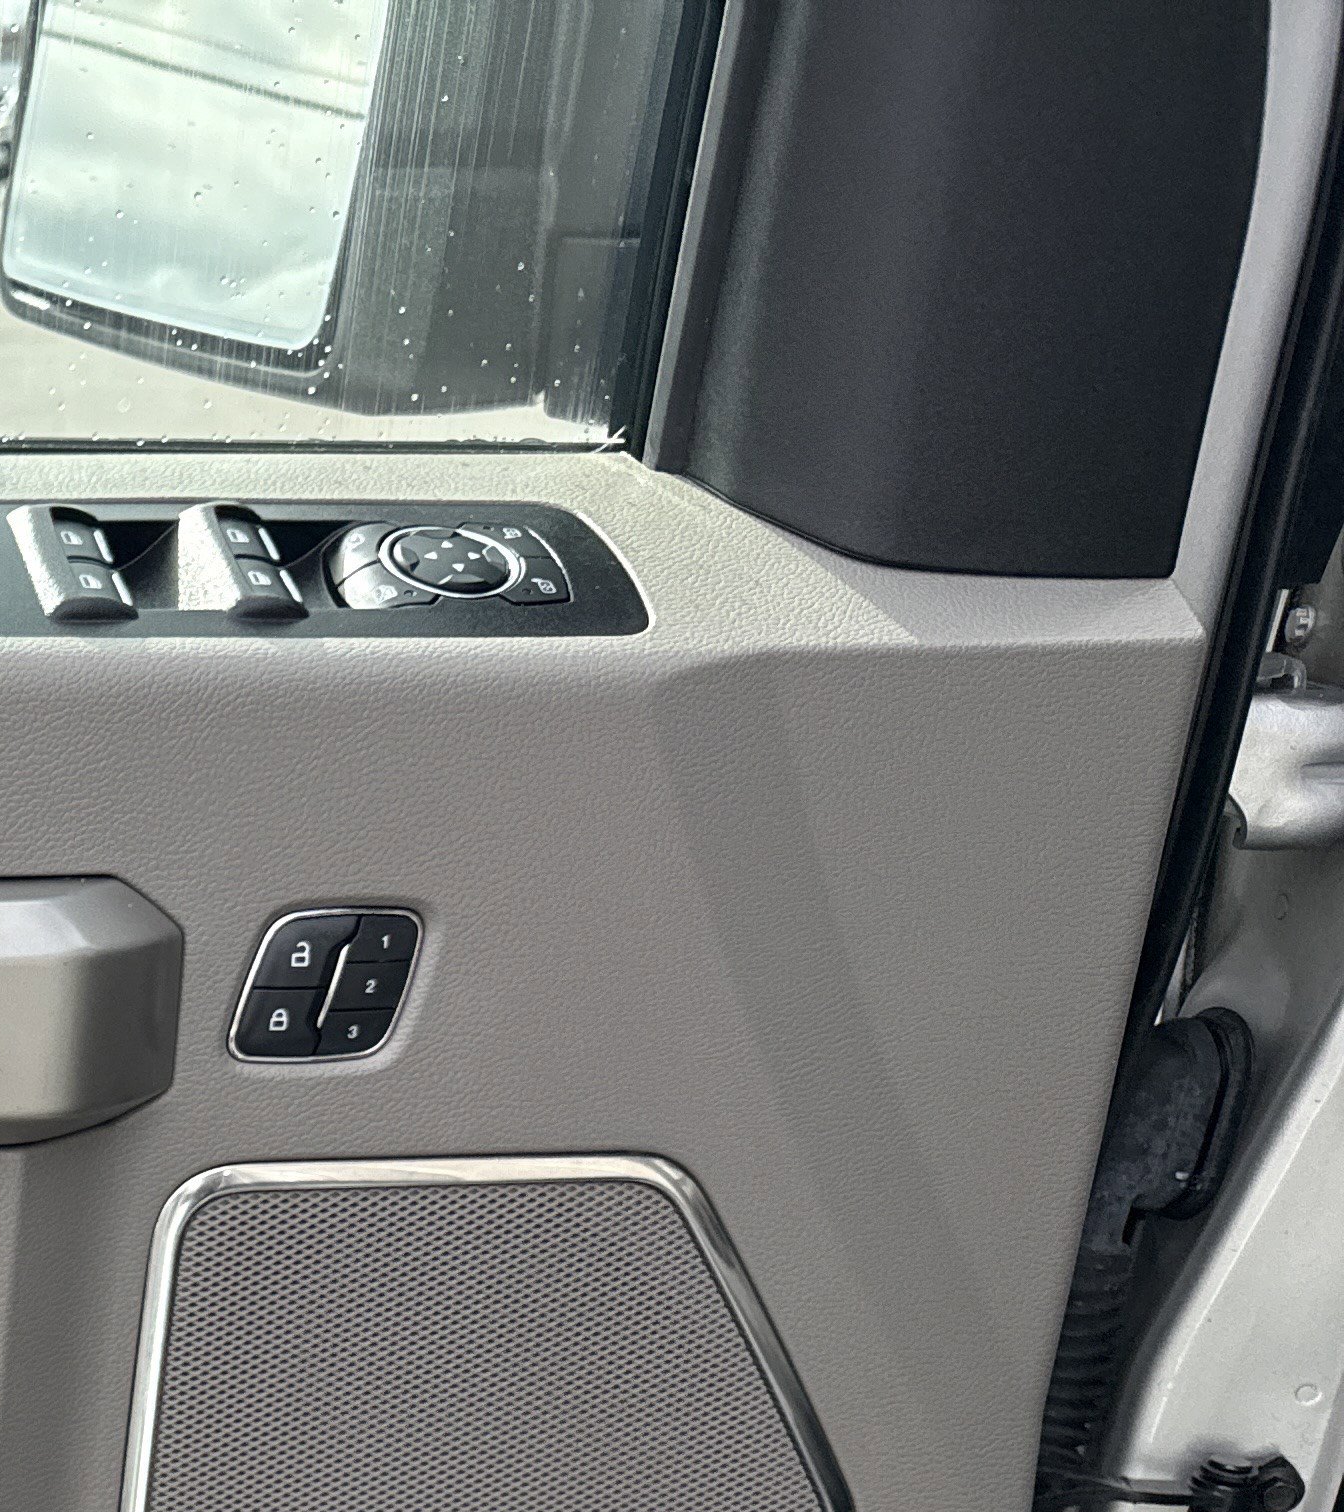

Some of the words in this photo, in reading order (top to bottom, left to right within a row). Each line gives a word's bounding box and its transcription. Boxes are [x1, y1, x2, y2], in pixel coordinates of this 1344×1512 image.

[381, 934, 392, 949] 1
[364, 978, 378, 994] 2
[347, 1024, 360, 1039] 3
